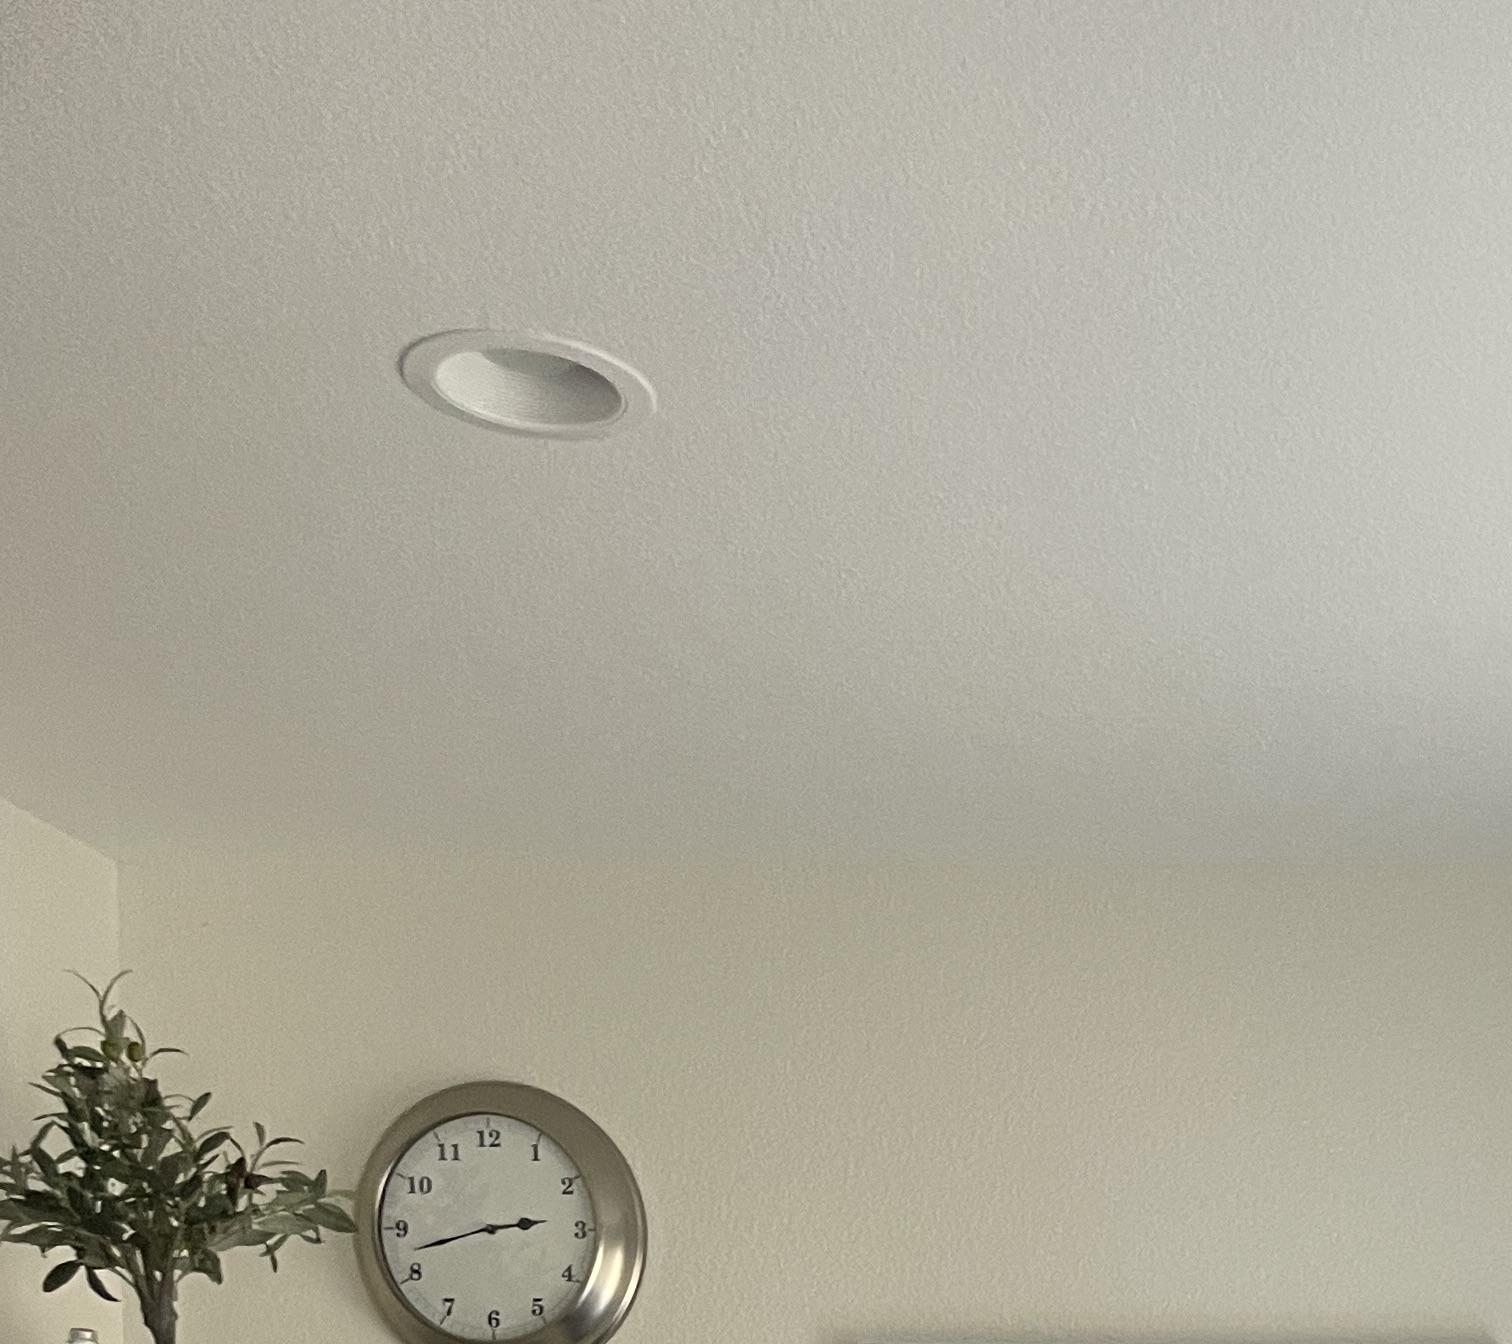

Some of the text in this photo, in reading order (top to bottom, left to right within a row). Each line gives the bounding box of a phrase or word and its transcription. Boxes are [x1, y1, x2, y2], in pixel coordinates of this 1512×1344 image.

[476, 1130, 501, 1148] 12
[438, 1143, 461, 1161] 11
[531, 1143, 541, 1162] 1
[407, 1176, 433, 1195] 10
[561, 1177, 575, 1195] 2
[395, 1219, 409, 1238] 9
[574, 1220, 587, 1239] 3
[409, 1262, 422, 1281] 8
[561, 1264, 574, 1282] 4
[442, 1298, 455, 1316] 7
[531, 1298, 544, 1316] 5
[488, 1310, 500, 1329] 6
